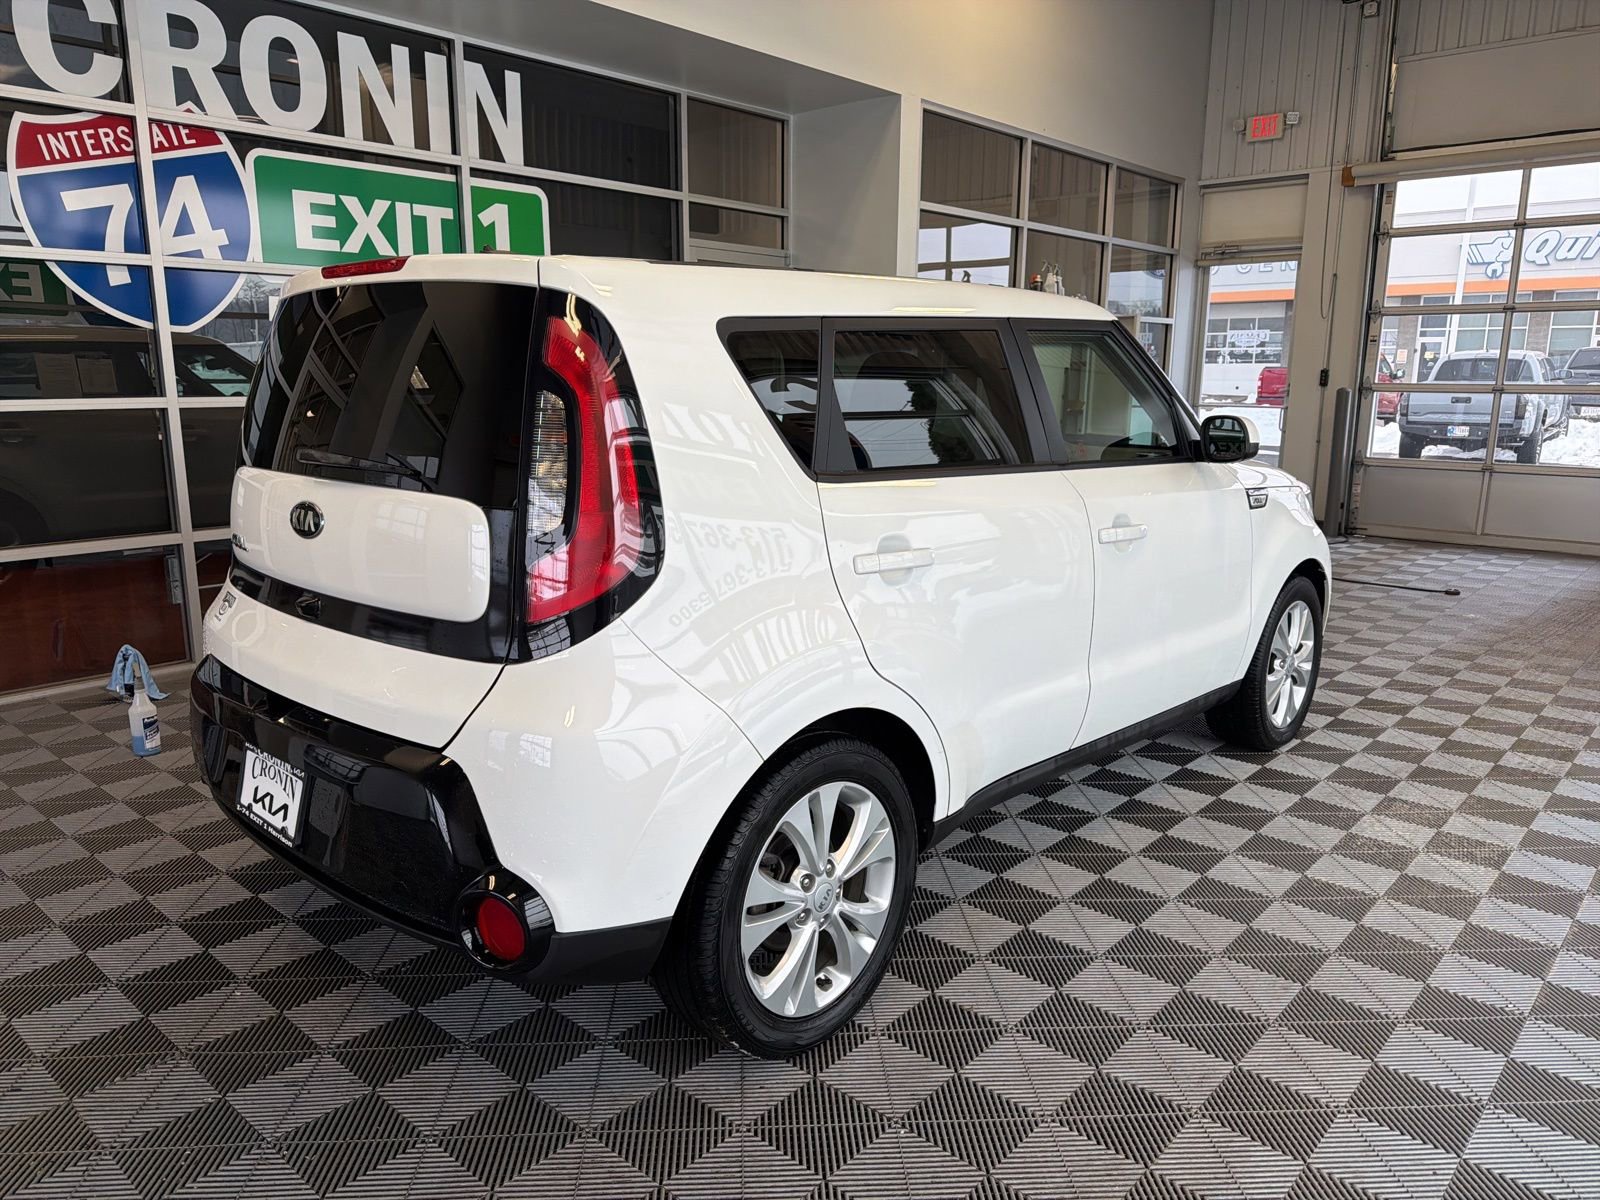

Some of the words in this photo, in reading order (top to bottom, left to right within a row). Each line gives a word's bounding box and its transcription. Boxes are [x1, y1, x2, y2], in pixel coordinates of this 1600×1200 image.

[13, 0, 524, 167] CRONIN
[37, 123, 197, 161] INTERSATE
[1251, 113, 1279, 138] EXIT
[61, 176, 229, 287] 74
[292, 189, 454, 256] EXIT
[477, 203, 511, 256] 1
[252, 756, 298, 804] CRONIN
[268, 826, 293, 848] Harrison
